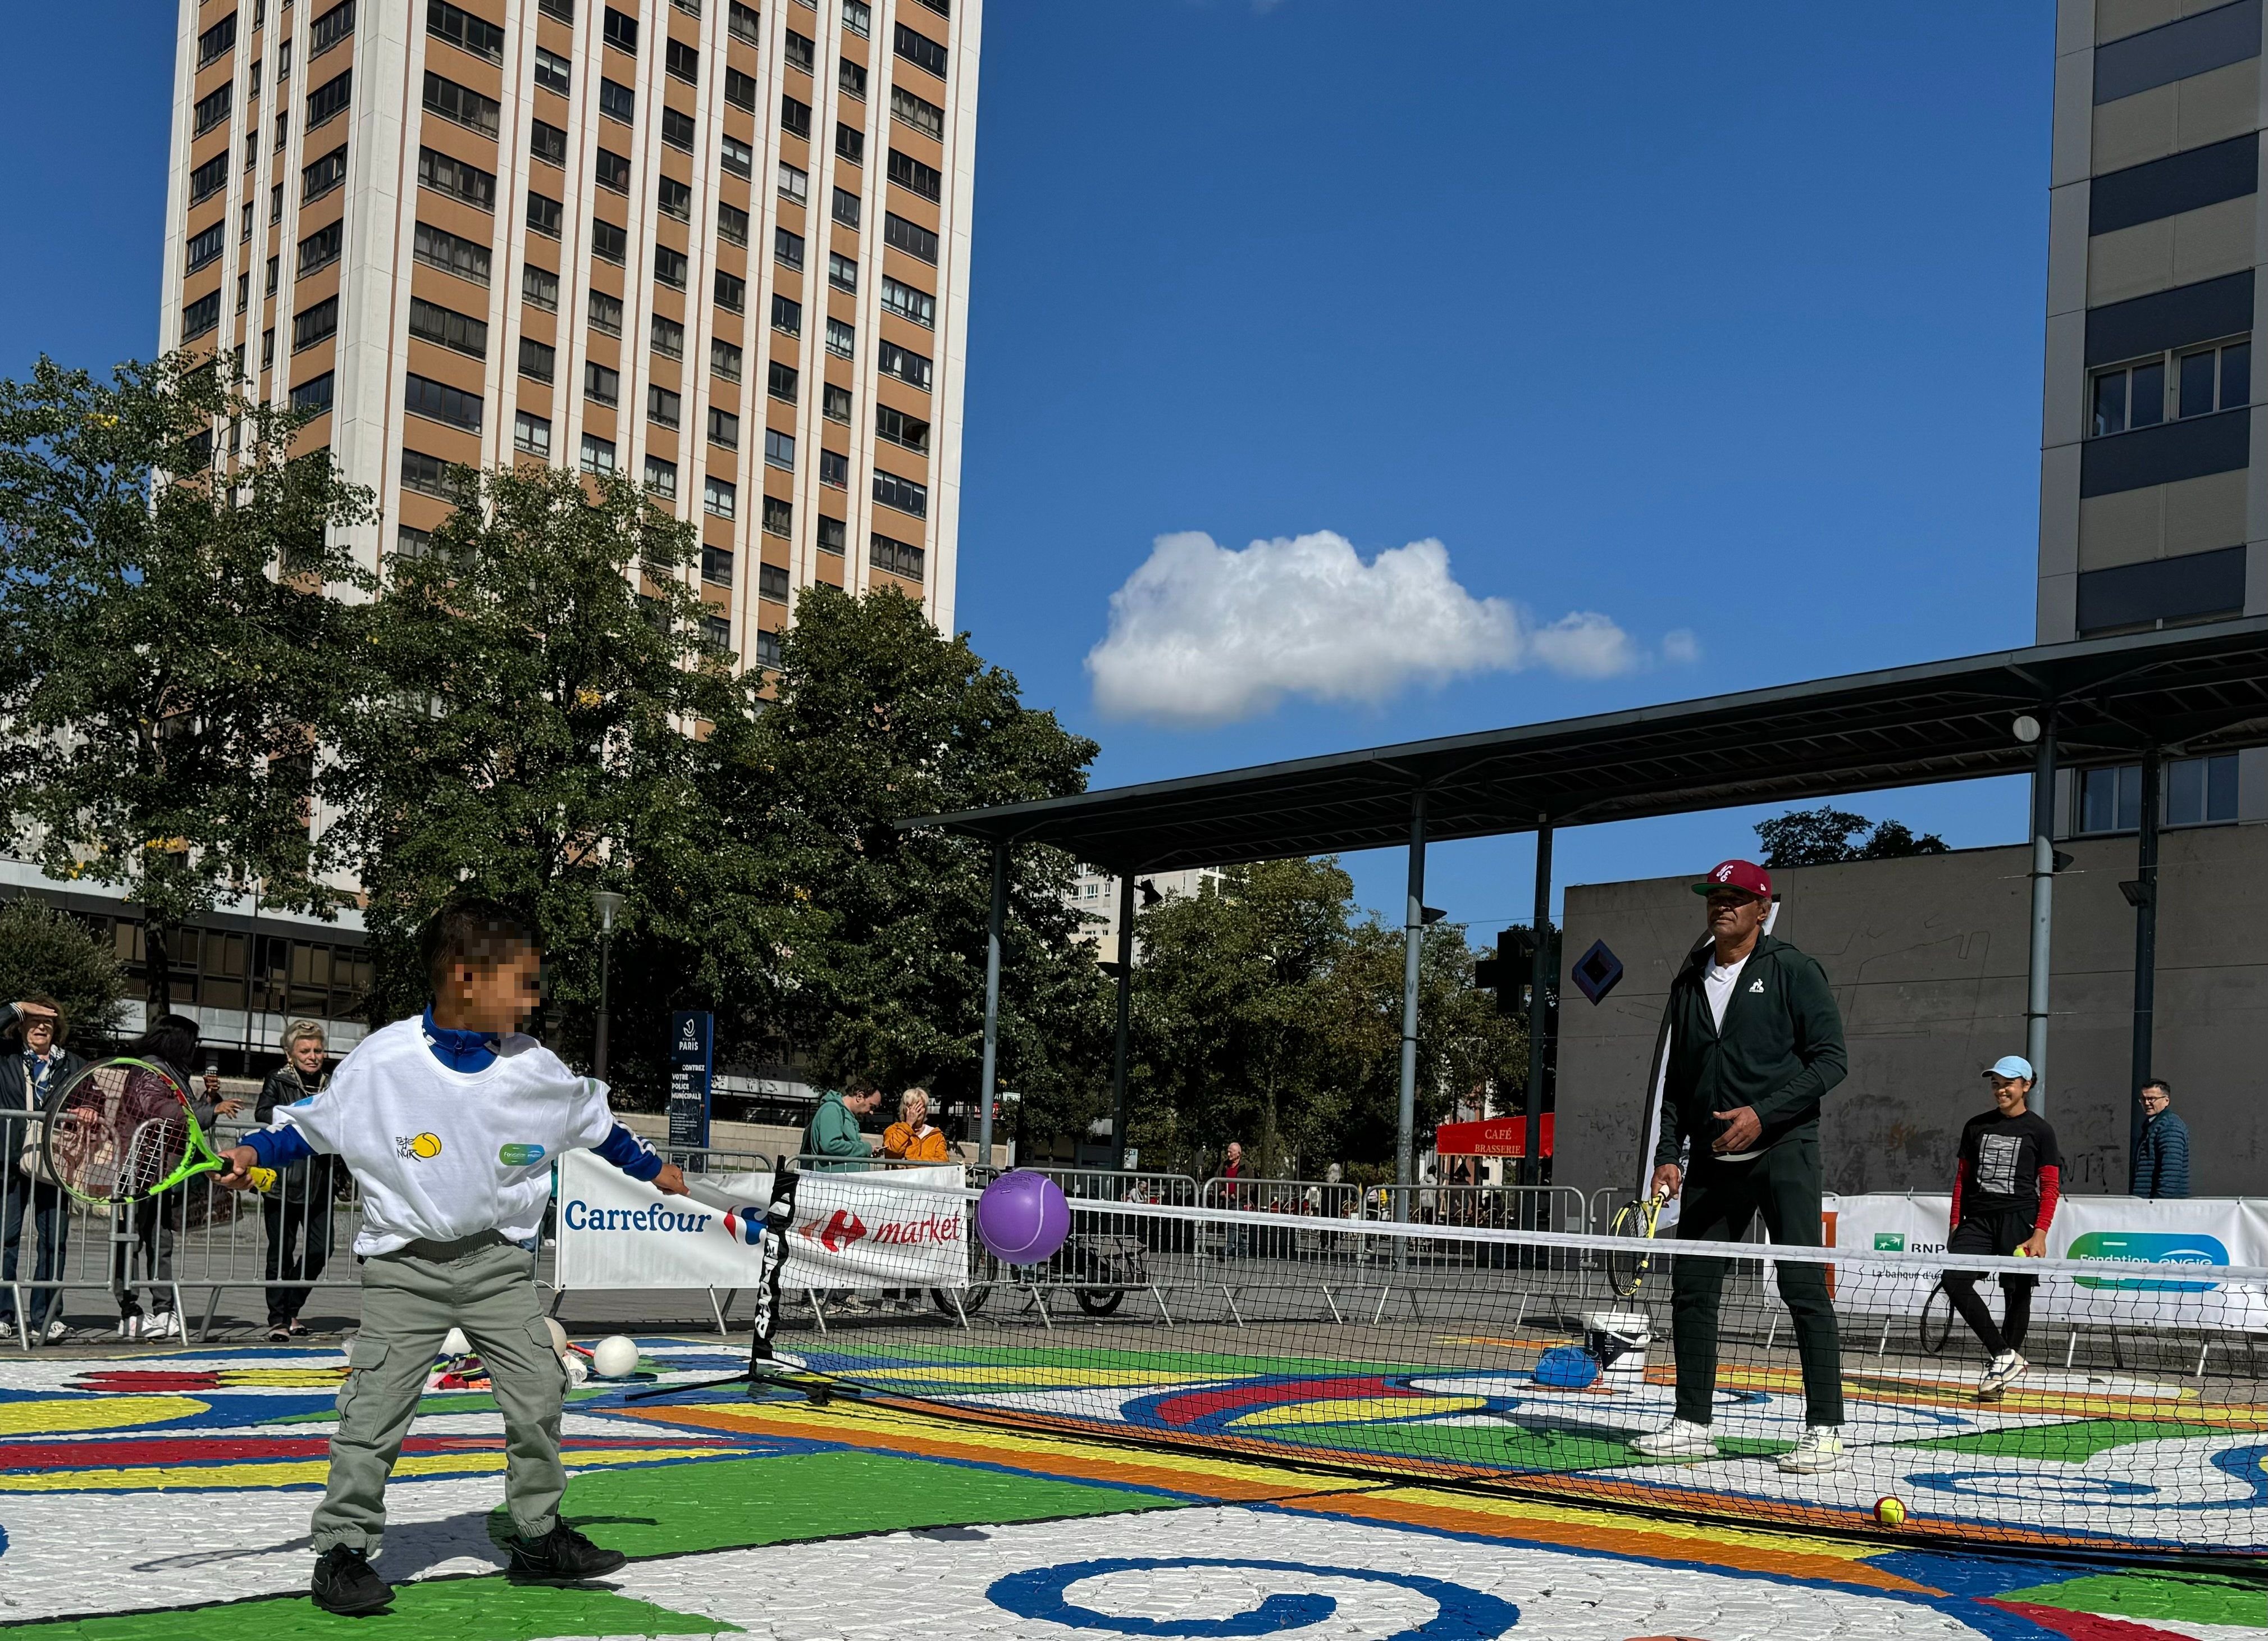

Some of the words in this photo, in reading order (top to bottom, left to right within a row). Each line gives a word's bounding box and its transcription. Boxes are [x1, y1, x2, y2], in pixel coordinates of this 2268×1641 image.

[679, 1041, 699, 1051] PARIS
[1485, 1127, 1512, 1140] CAFÉ
[1475, 1144, 1521, 1154] BRASSERIE
[564, 1200, 712, 1233] Carrefour
[871, 1210, 961, 1246] market
[1886, 1269, 1919, 1280] banque
